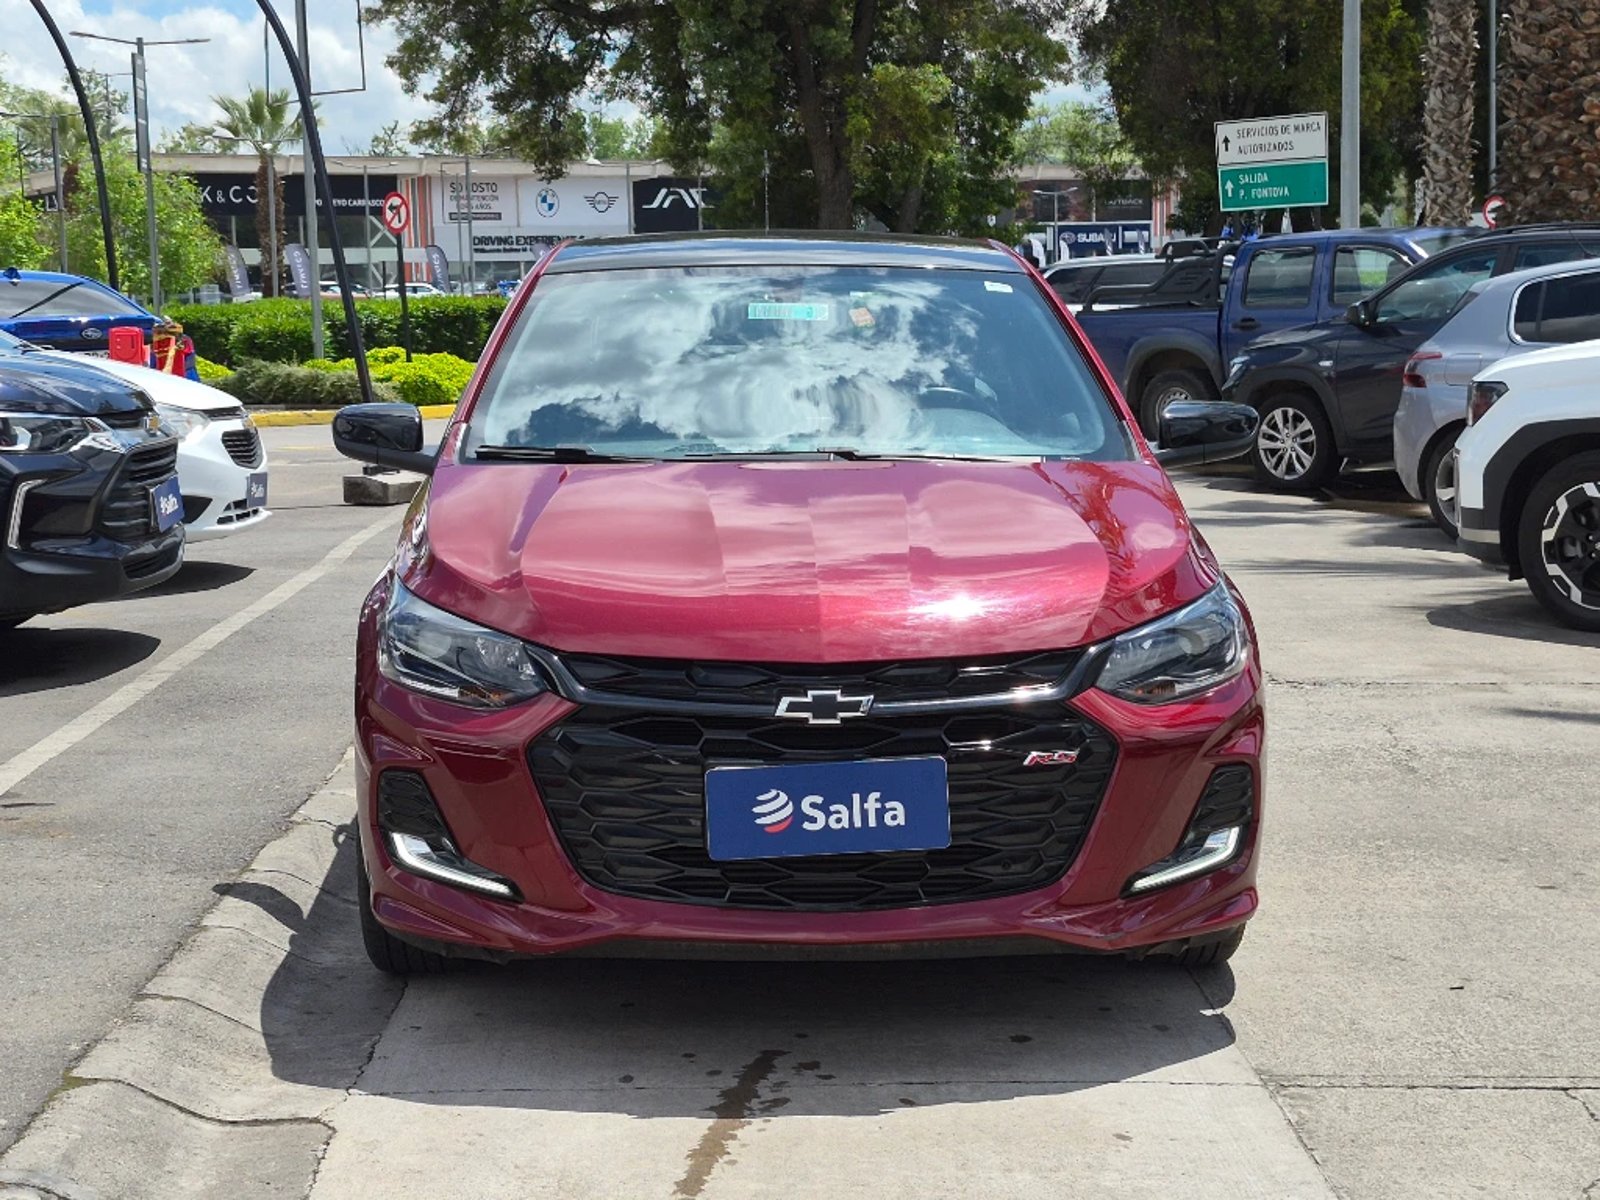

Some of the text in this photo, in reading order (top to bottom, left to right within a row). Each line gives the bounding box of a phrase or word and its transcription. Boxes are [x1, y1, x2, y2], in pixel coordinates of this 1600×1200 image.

[1237, 121, 1321, 139] SERVICIOS DE MARCA
[1238, 140, 1294, 155] AUTORIZADOS
[1238, 172, 1269, 185] SALIDA
[466, 182, 498, 193] OSTO
[1251, 186, 1290, 199] FONTOVA
[642, 187, 715, 209] JAC
[473, 235, 515, 246] DRIVING
[1077, 232, 1117, 243] SUBAU
[800, 791, 906, 832] Salfa
